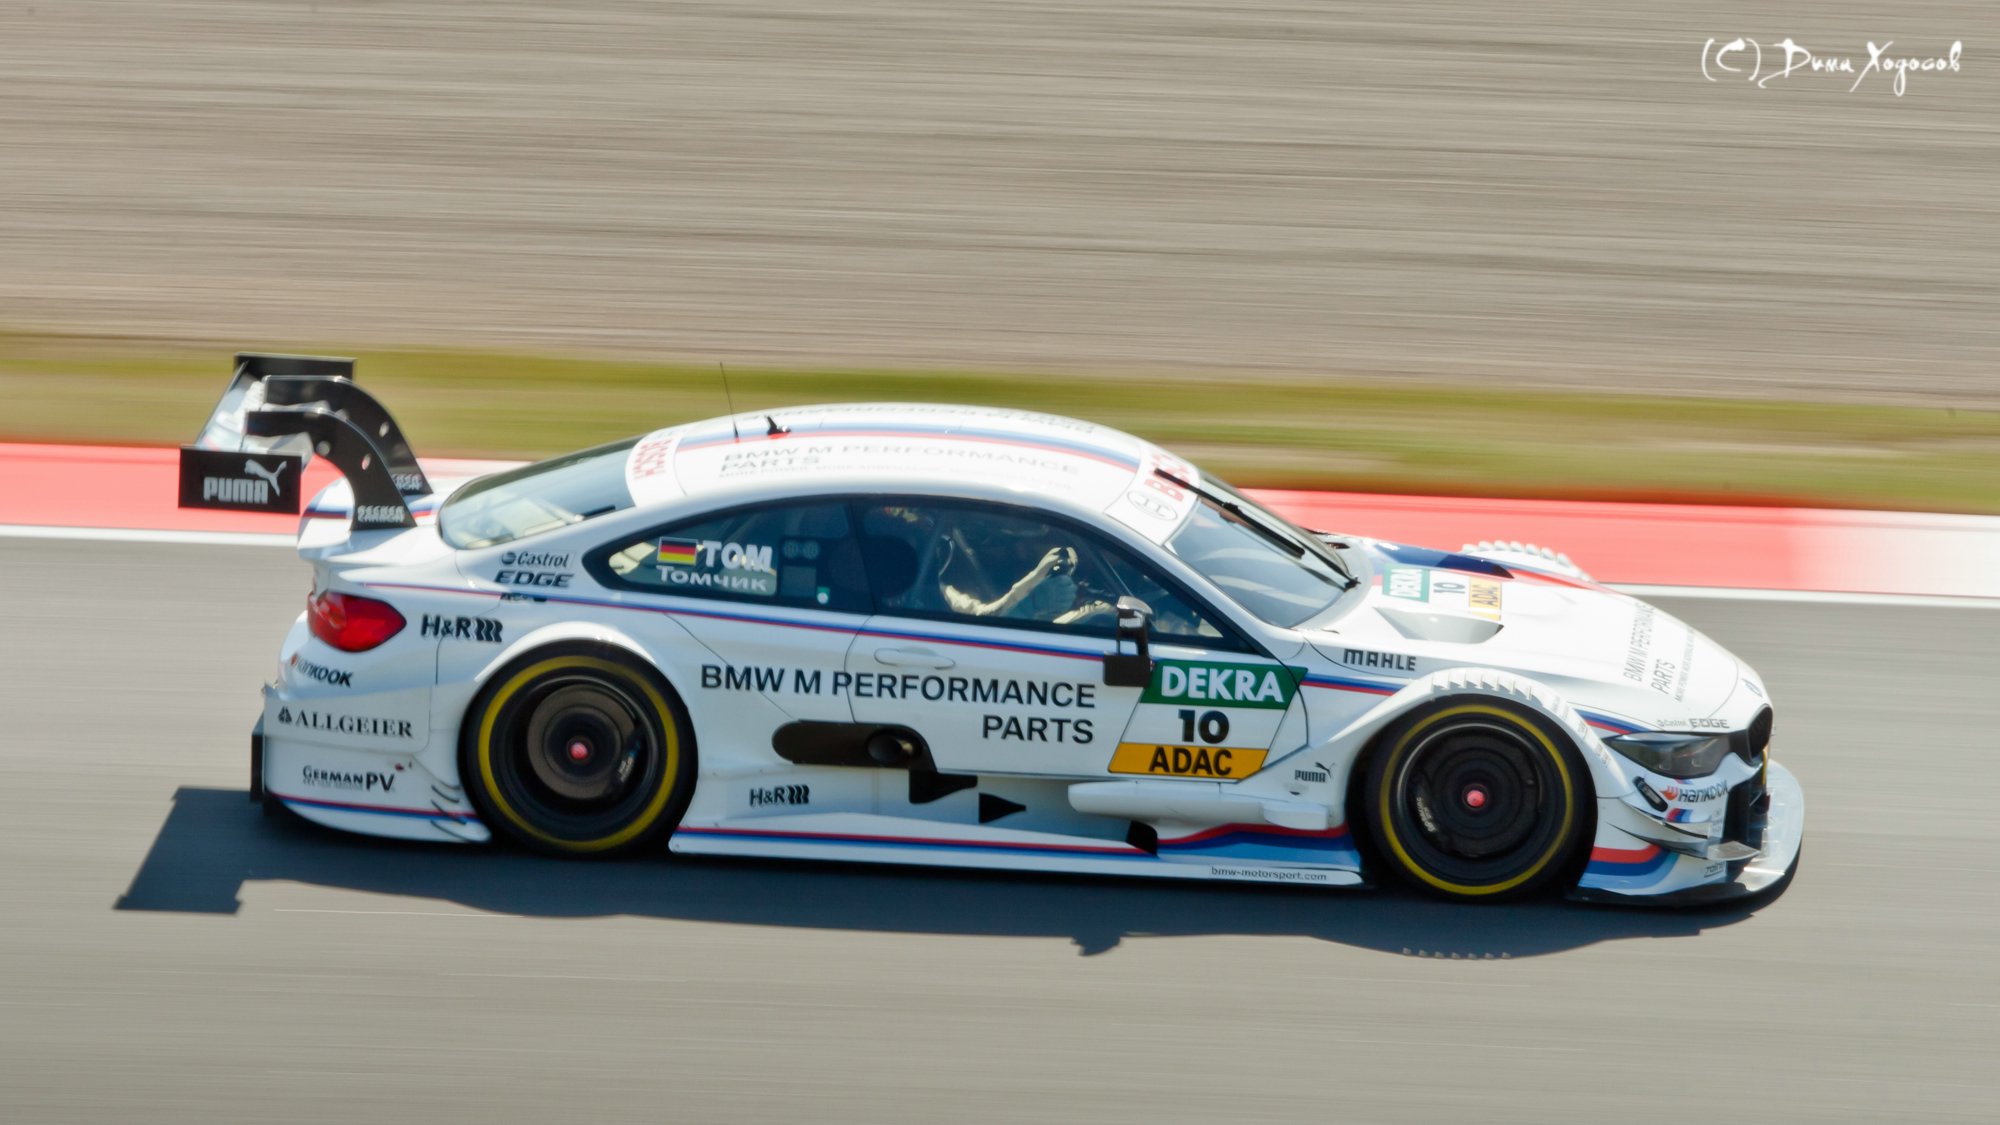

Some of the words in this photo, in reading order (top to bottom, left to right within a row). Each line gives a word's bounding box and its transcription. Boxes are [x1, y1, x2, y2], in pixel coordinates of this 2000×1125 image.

[719, 456, 821, 472] PARTS
[723, 446, 799, 462] BMW
[807, 445, 827, 455] M
[842, 443, 1080, 475] PERFORMANCE
[203, 477, 269, 504] PUMA
[517, 551, 569, 568] Castrol
[702, 540, 774, 572] TOM
[494, 570, 575, 588] EDGE
[1432, 582, 1466, 594] 10
[421, 614, 472, 639] H&R
[1342, 648, 1417, 672] MAHLE
[700, 664, 785, 693] BMW
[793, 669, 822, 695] M
[832, 671, 1096, 708] PERFORMANCE
[1161, 665, 1285, 703] DEKRA
[1651, 659, 1676, 695] PARTS
[295, 709, 414, 739] ALLGEIER
[982, 714, 1094, 744] PARTS
[1178, 709, 1230, 744] 10
[1688, 718, 1730, 729] EDGE
[1148, 746, 1233, 776] ADAC
[1294, 769, 1327, 783] PUMA
[749, 787, 785, 807] H&R
[1211, 866, 1327, 882] bmw-motorsport.com
